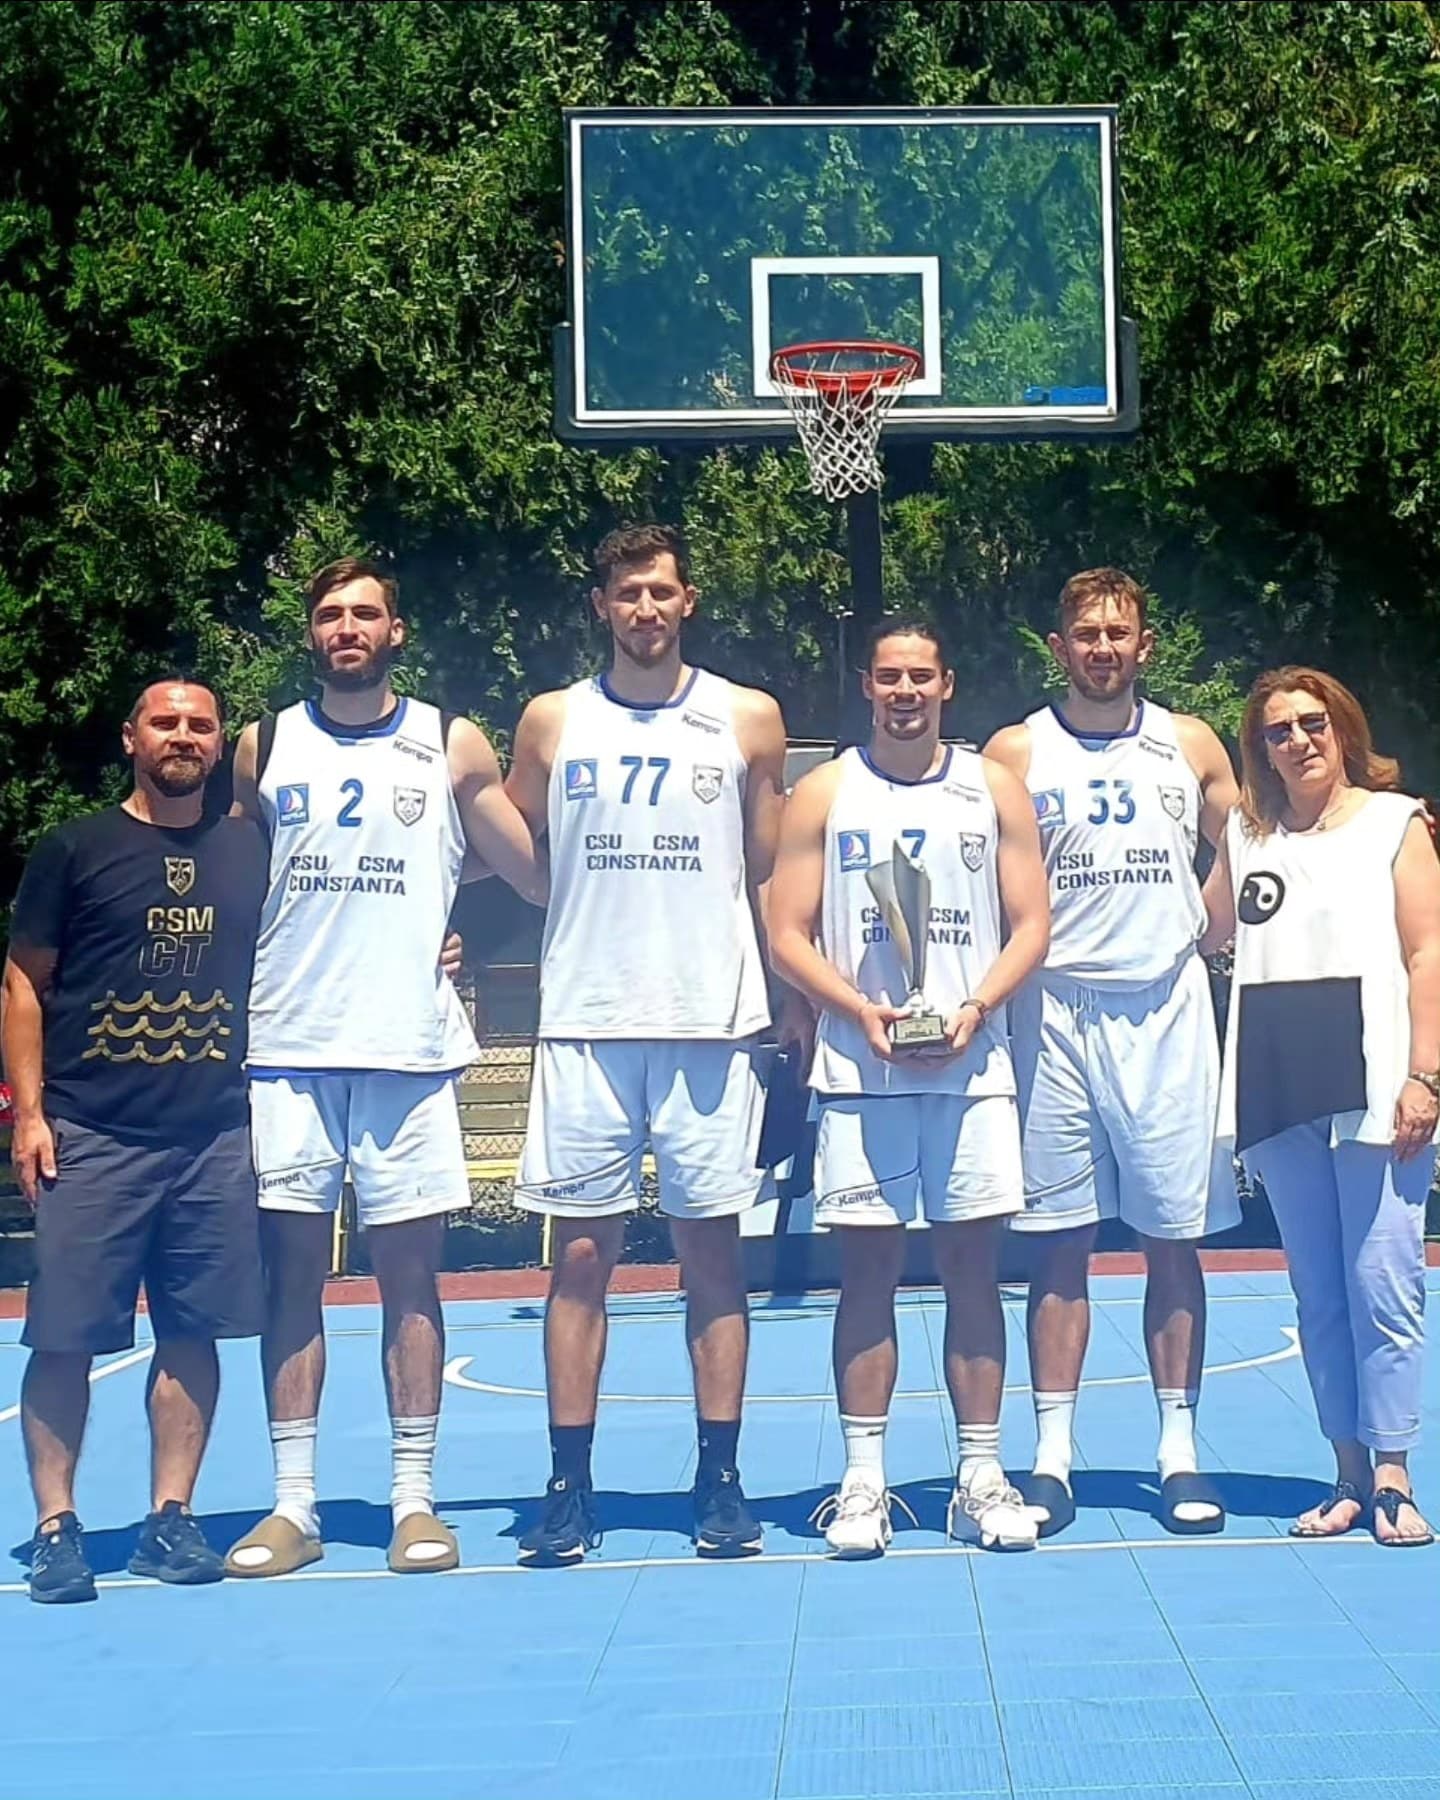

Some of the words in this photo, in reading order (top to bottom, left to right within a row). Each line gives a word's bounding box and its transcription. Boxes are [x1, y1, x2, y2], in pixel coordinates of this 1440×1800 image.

[620, 755, 671, 806] 77
[336, 778, 364, 827] 2
[1087, 779, 1136, 825] 33
[586, 834, 622, 850] CSU
[653, 835, 700, 851] CSM
[902, 829, 926, 858] 7
[290, 855, 328, 871] CSU
[358, 855, 405, 874] CSM
[587, 854, 703, 872] CONSTANTA
[1056, 852, 1094, 871] CSU
[1125, 848, 1169, 865] CSM
[290, 874, 406, 896] CONSTANTA
[1056, 868, 1174, 890] CONSTANTA
[147, 906, 214, 932] CSM
[930, 907, 970, 925] CSM
[139, 933, 212, 977] CT
